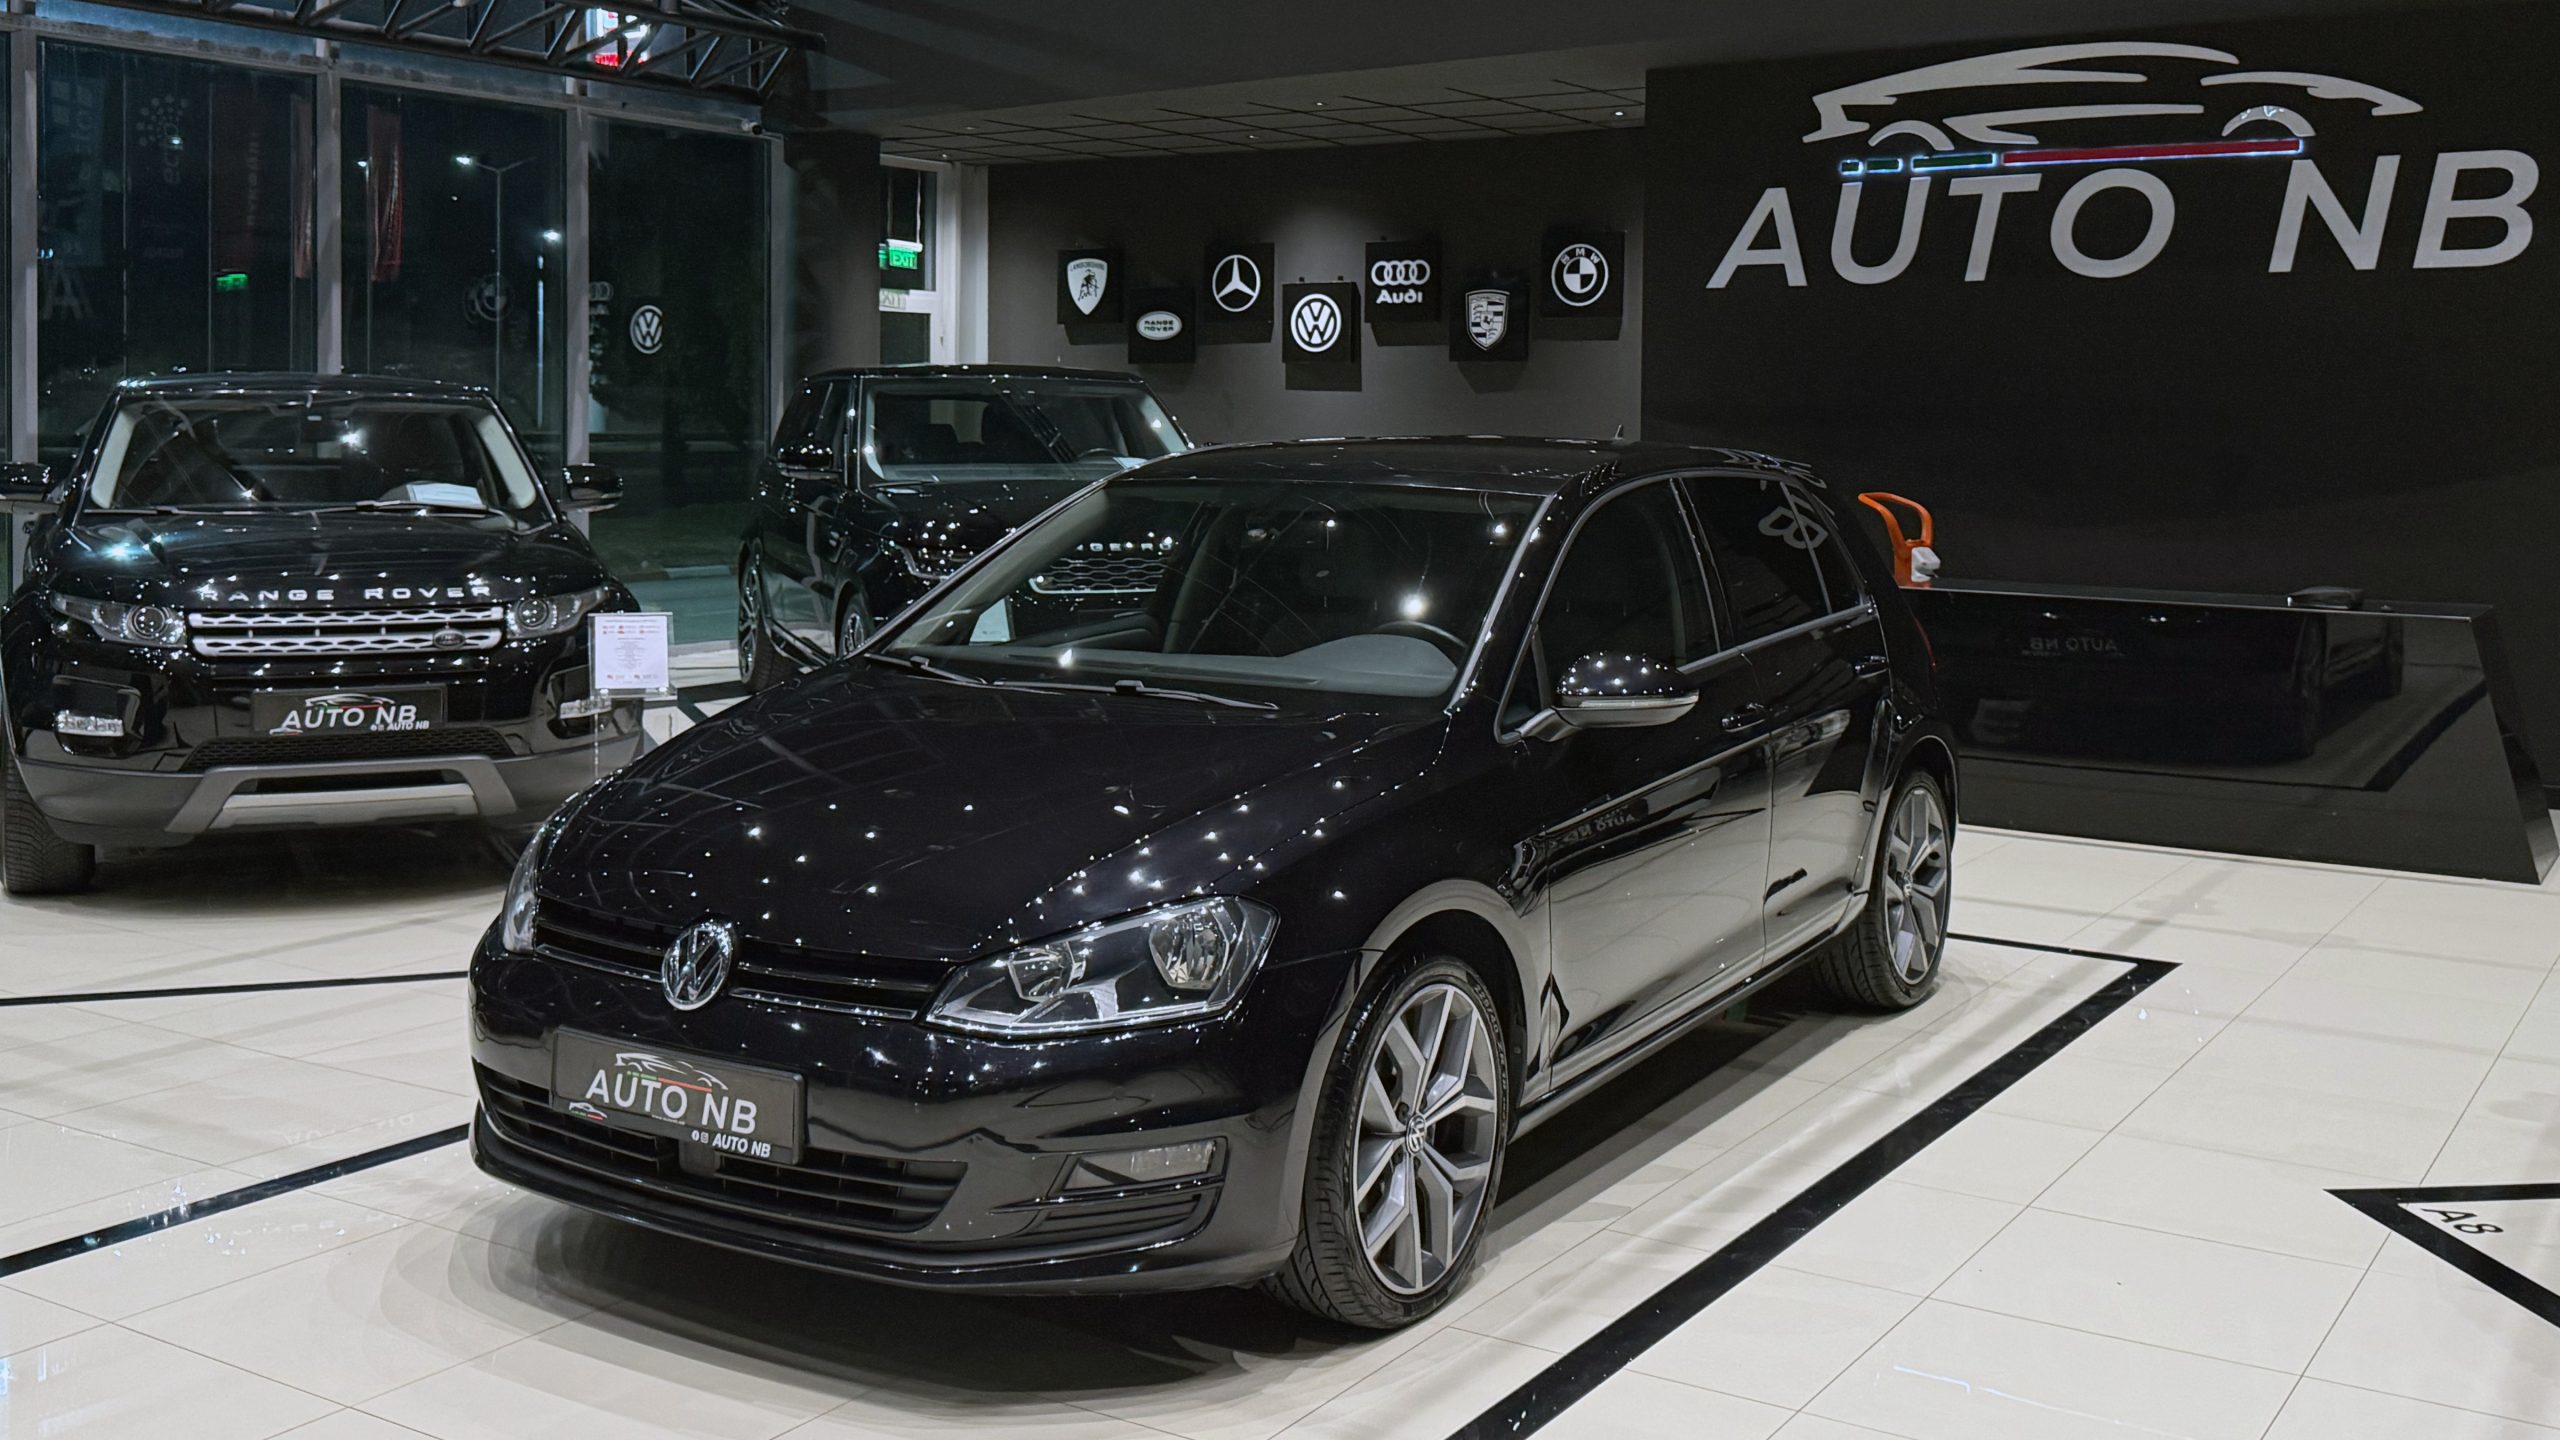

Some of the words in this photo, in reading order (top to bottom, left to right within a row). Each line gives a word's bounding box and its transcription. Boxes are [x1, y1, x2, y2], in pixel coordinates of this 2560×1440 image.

[1706, 168, 2176, 289] AUTO
[2269, 149, 2541, 272] NB
[1560, 247, 1601, 265] BMW
[1376, 289, 1423, 304] Audi
[200, 588, 334, 601] RANGE
[364, 585, 491, 599] ROVER
[281, 706, 365, 729] AUTO
[374, 705, 417, 727] NB
[386, 720, 414, 731] AUTO
[585, 1069, 688, 1119] AUTO
[701, 1093, 758, 1134] NB
[712, 1135, 749, 1154] AUTO
[750, 1141, 772, 1158] NB
[2421, 1208, 2504, 1234] A8
